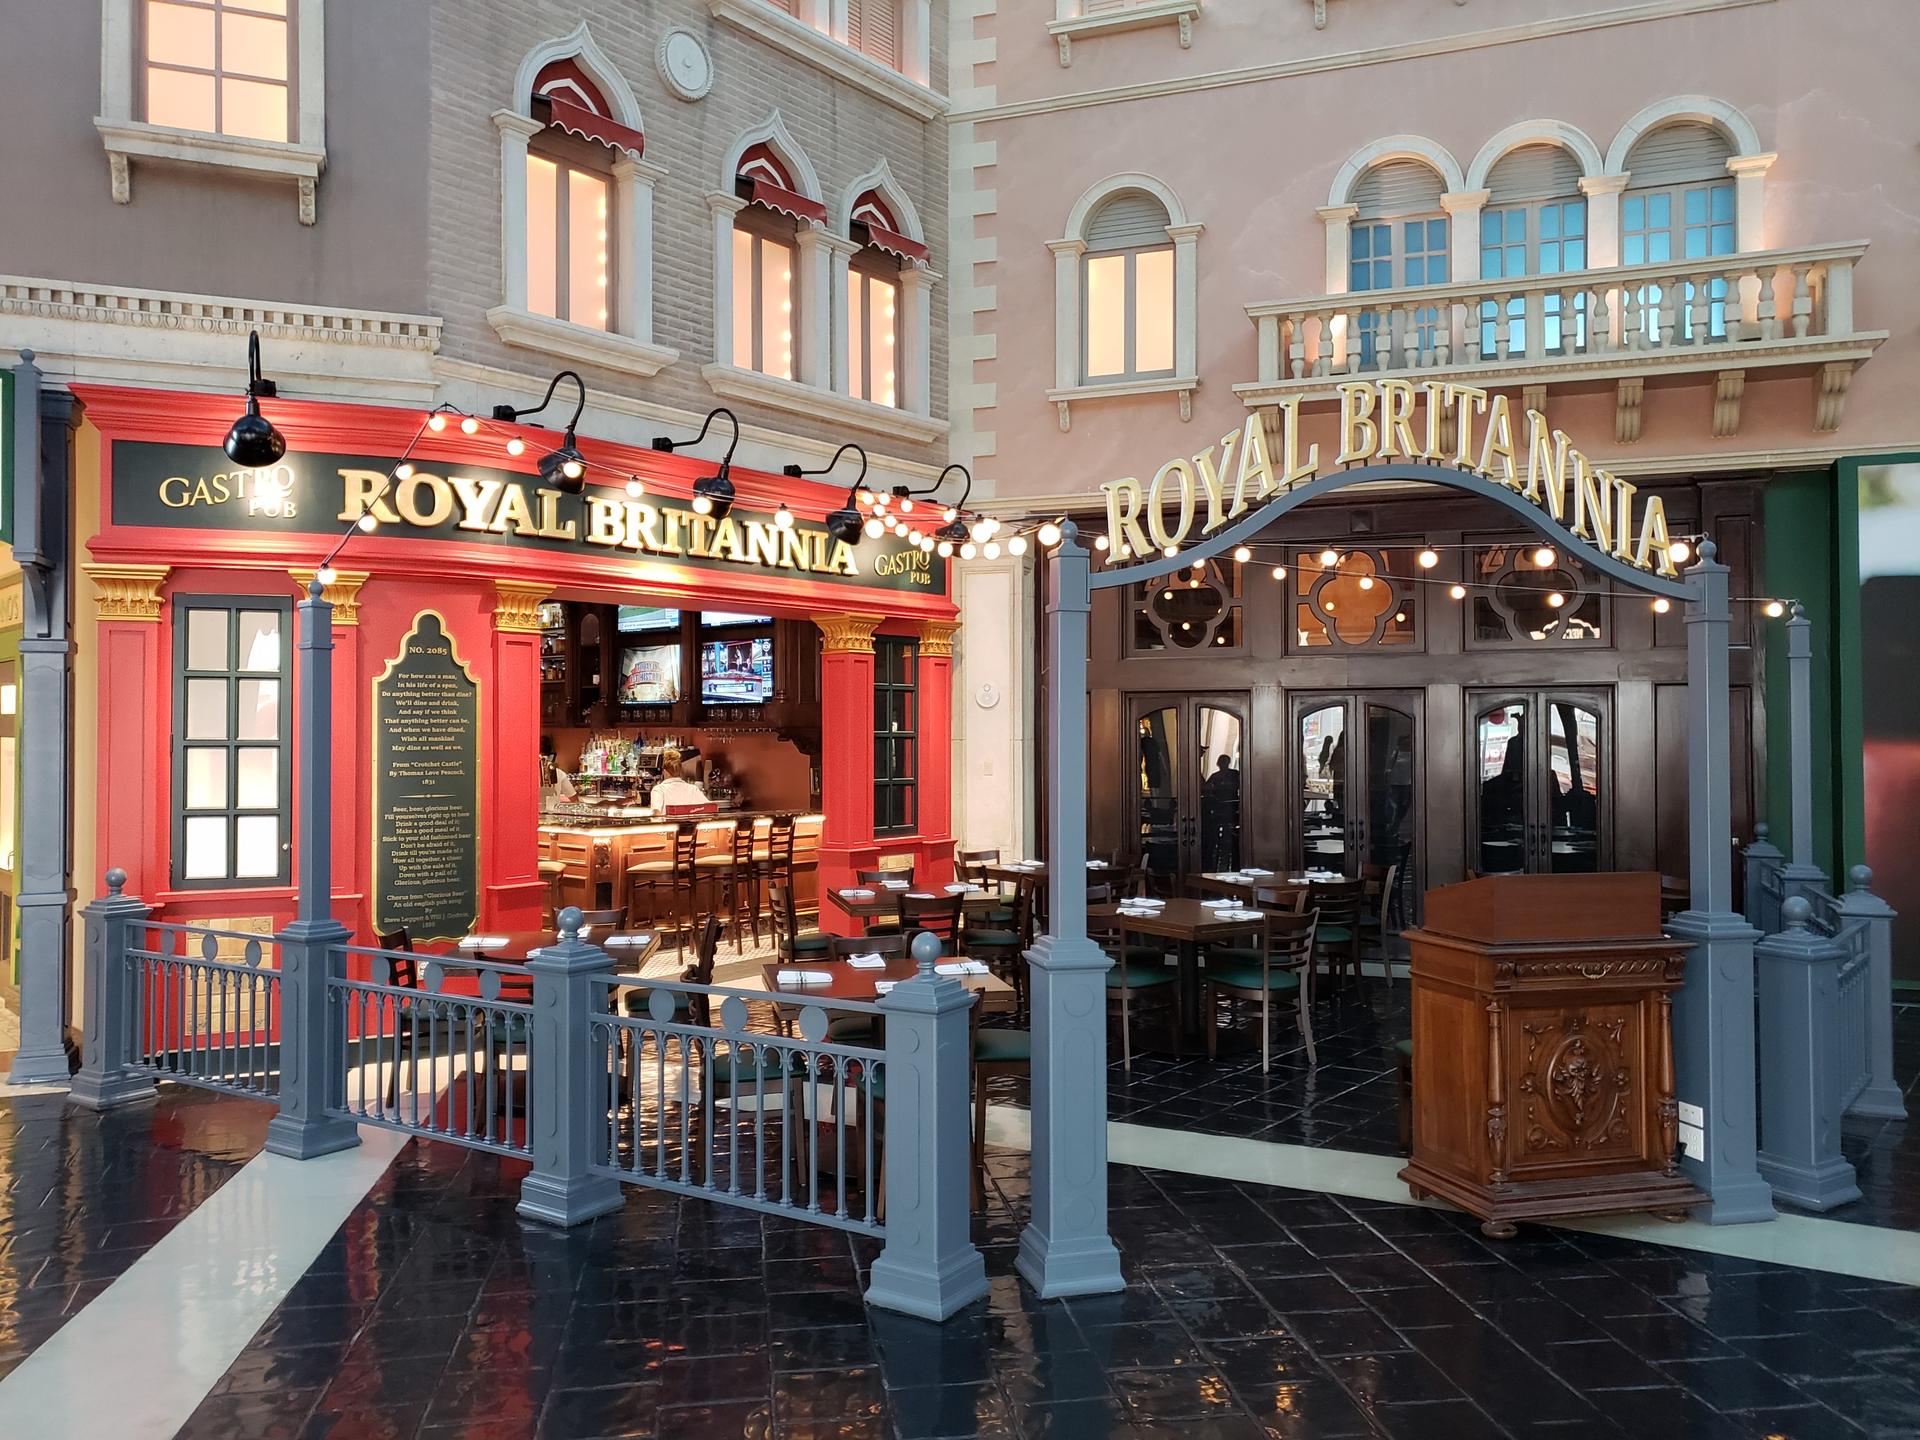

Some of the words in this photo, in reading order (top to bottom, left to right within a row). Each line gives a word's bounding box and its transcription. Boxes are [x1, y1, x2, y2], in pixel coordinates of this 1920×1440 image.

[158, 464, 296, 509] GASTRO
[1100, 393, 1320, 565] ROYAL
[1335, 378, 1678, 578] BRITANNIA
[248, 500, 297, 519] PUB
[337, 468, 576, 540] ROYAL
[585, 495, 859, 576] BRITANNIA
[873, 549, 932, 577] GASTRO
[909, 570, 932, 585] PUB
[426, 648, 448, 656] 2085
